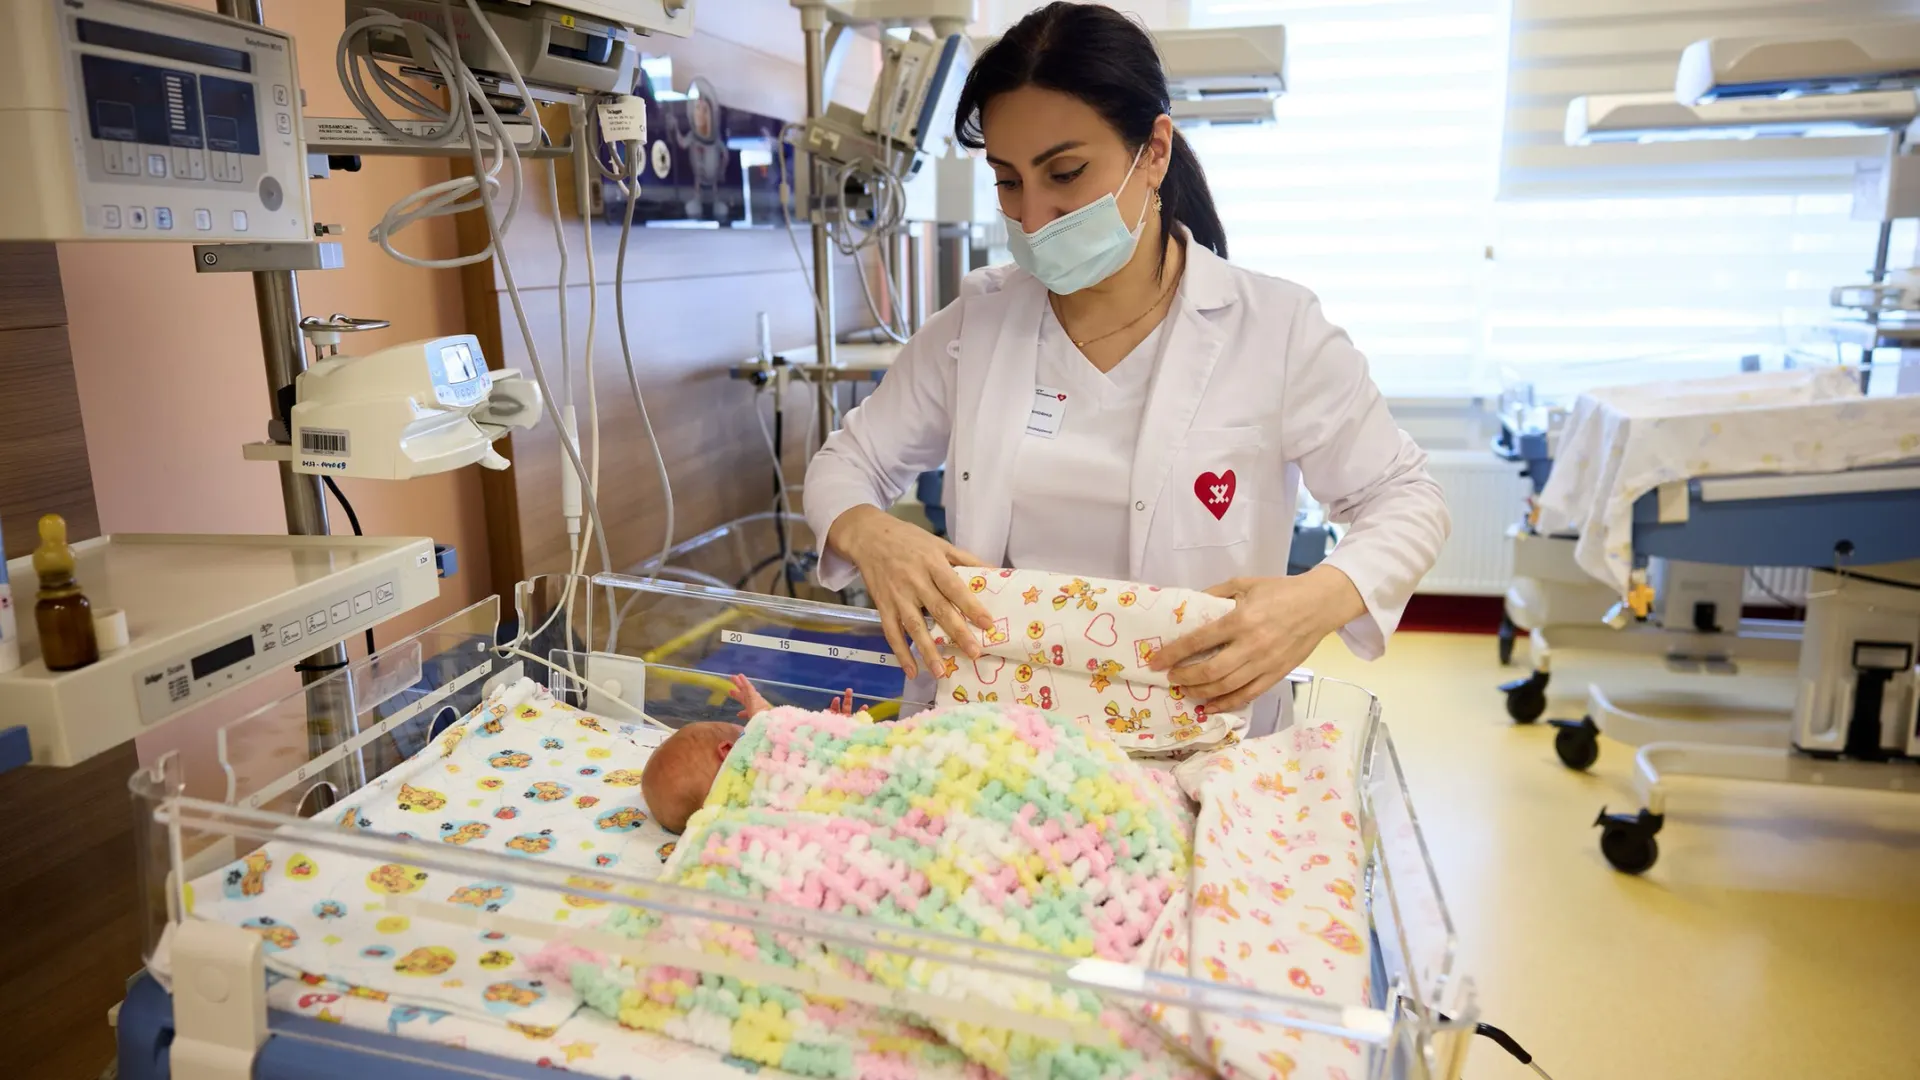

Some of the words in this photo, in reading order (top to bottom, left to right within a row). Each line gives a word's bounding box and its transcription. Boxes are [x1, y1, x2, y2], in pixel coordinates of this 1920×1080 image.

[730, 633, 742, 643] 20
[779, 640, 790, 650] 15
[828, 647, 839, 657] 10
[880, 654, 886, 663] 5
[297, 768, 306, 781] B
[342, 744, 349, 753] A
[416, 702, 422, 712] A
[449, 682, 455, 693] B
[480, 664, 486, 675] C
